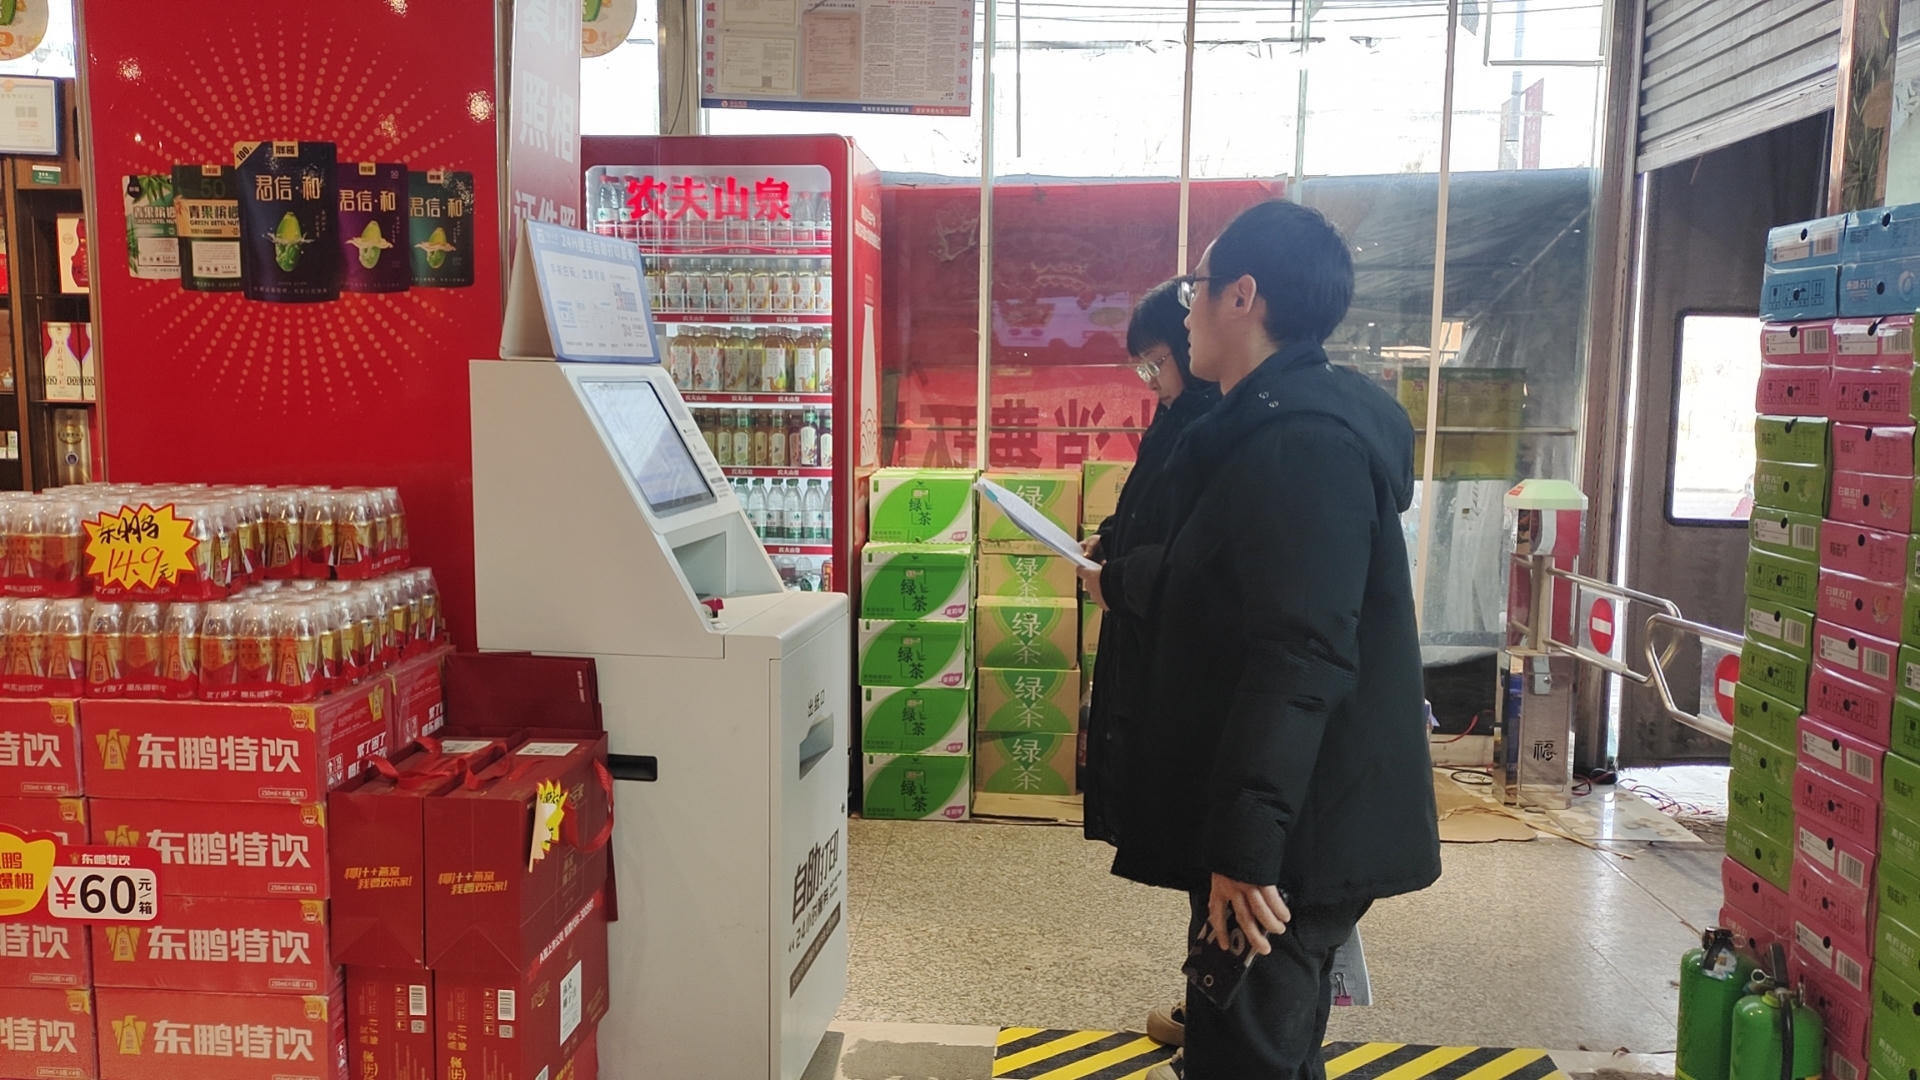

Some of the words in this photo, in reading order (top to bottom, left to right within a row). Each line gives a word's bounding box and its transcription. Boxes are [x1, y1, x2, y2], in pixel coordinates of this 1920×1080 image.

[519, 70, 573, 163] 照相
[255, 174, 322, 201] 君信·和
[339, 189, 396, 212] 君信·和
[409, 196, 463, 218] 君信·和
[625, 175, 793, 222] 农夫山泉
[1012, 612, 1042, 666] 绿茶
[1014, 675, 1044, 729] 绿茶
[137, 732, 301, 773] 东鹏特饮
[1011, 738, 1042, 791] 绿茶
[1533, 740, 1558, 762] 福
[0, 851, 22, 870] 鹏
[81, 853, 131, 866] 东鹏特饮
[147, 828, 312, 869] 东鹏特饮
[792, 828, 840, 926] 自助打印
[147, 924, 311, 965] 东鹏特饮
[153, 1018, 315, 1062] 东鹏特饮
